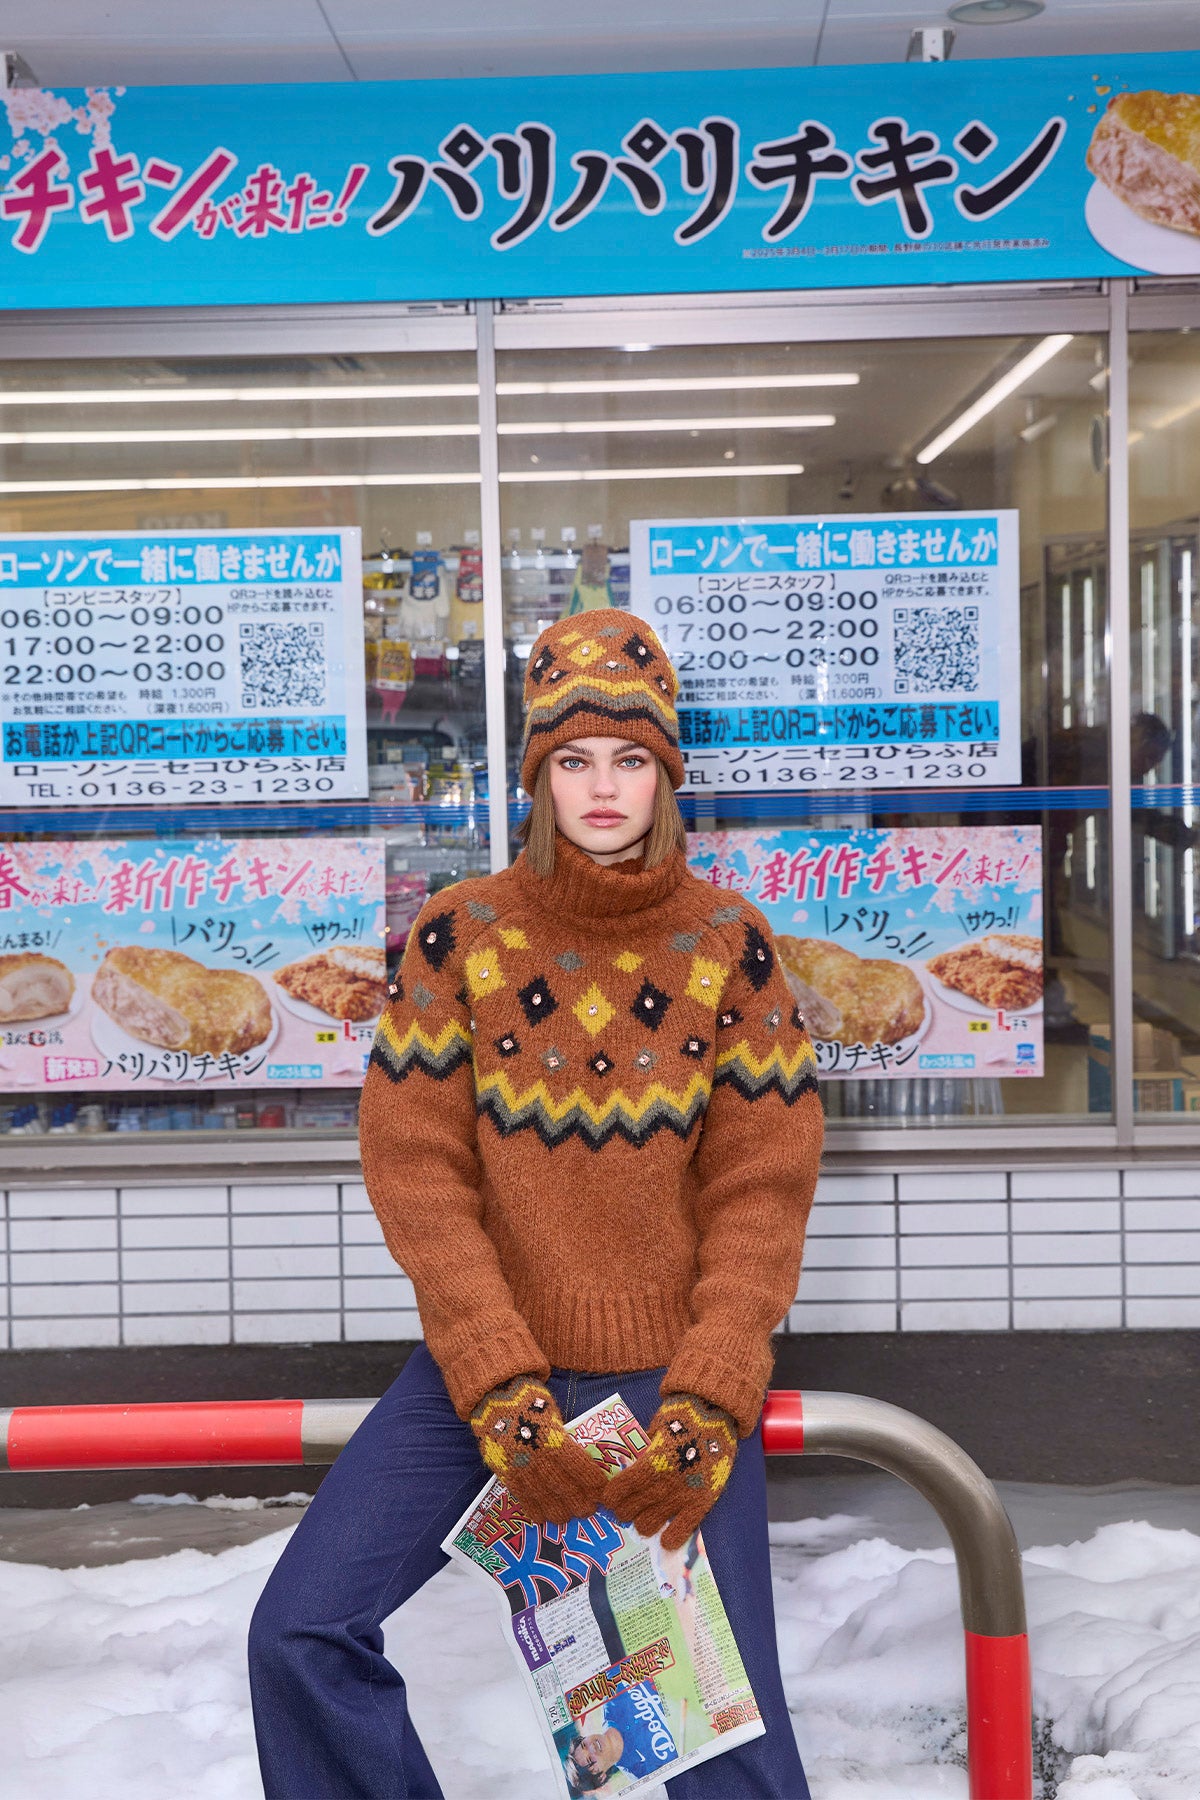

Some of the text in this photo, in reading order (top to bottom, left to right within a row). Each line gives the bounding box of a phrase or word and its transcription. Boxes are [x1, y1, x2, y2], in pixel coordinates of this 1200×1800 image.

[366, 117, 1068, 251] パリパリチキン
[0, 544, 341, 582] ローソンで一緒に働きませんか
[650, 528, 998, 568] ローソンで一緒に働きませんか
[13, 756, 346, 777] ローソンニセコひらふ店
[101, 1052, 267, 1081] パリパリチキン
